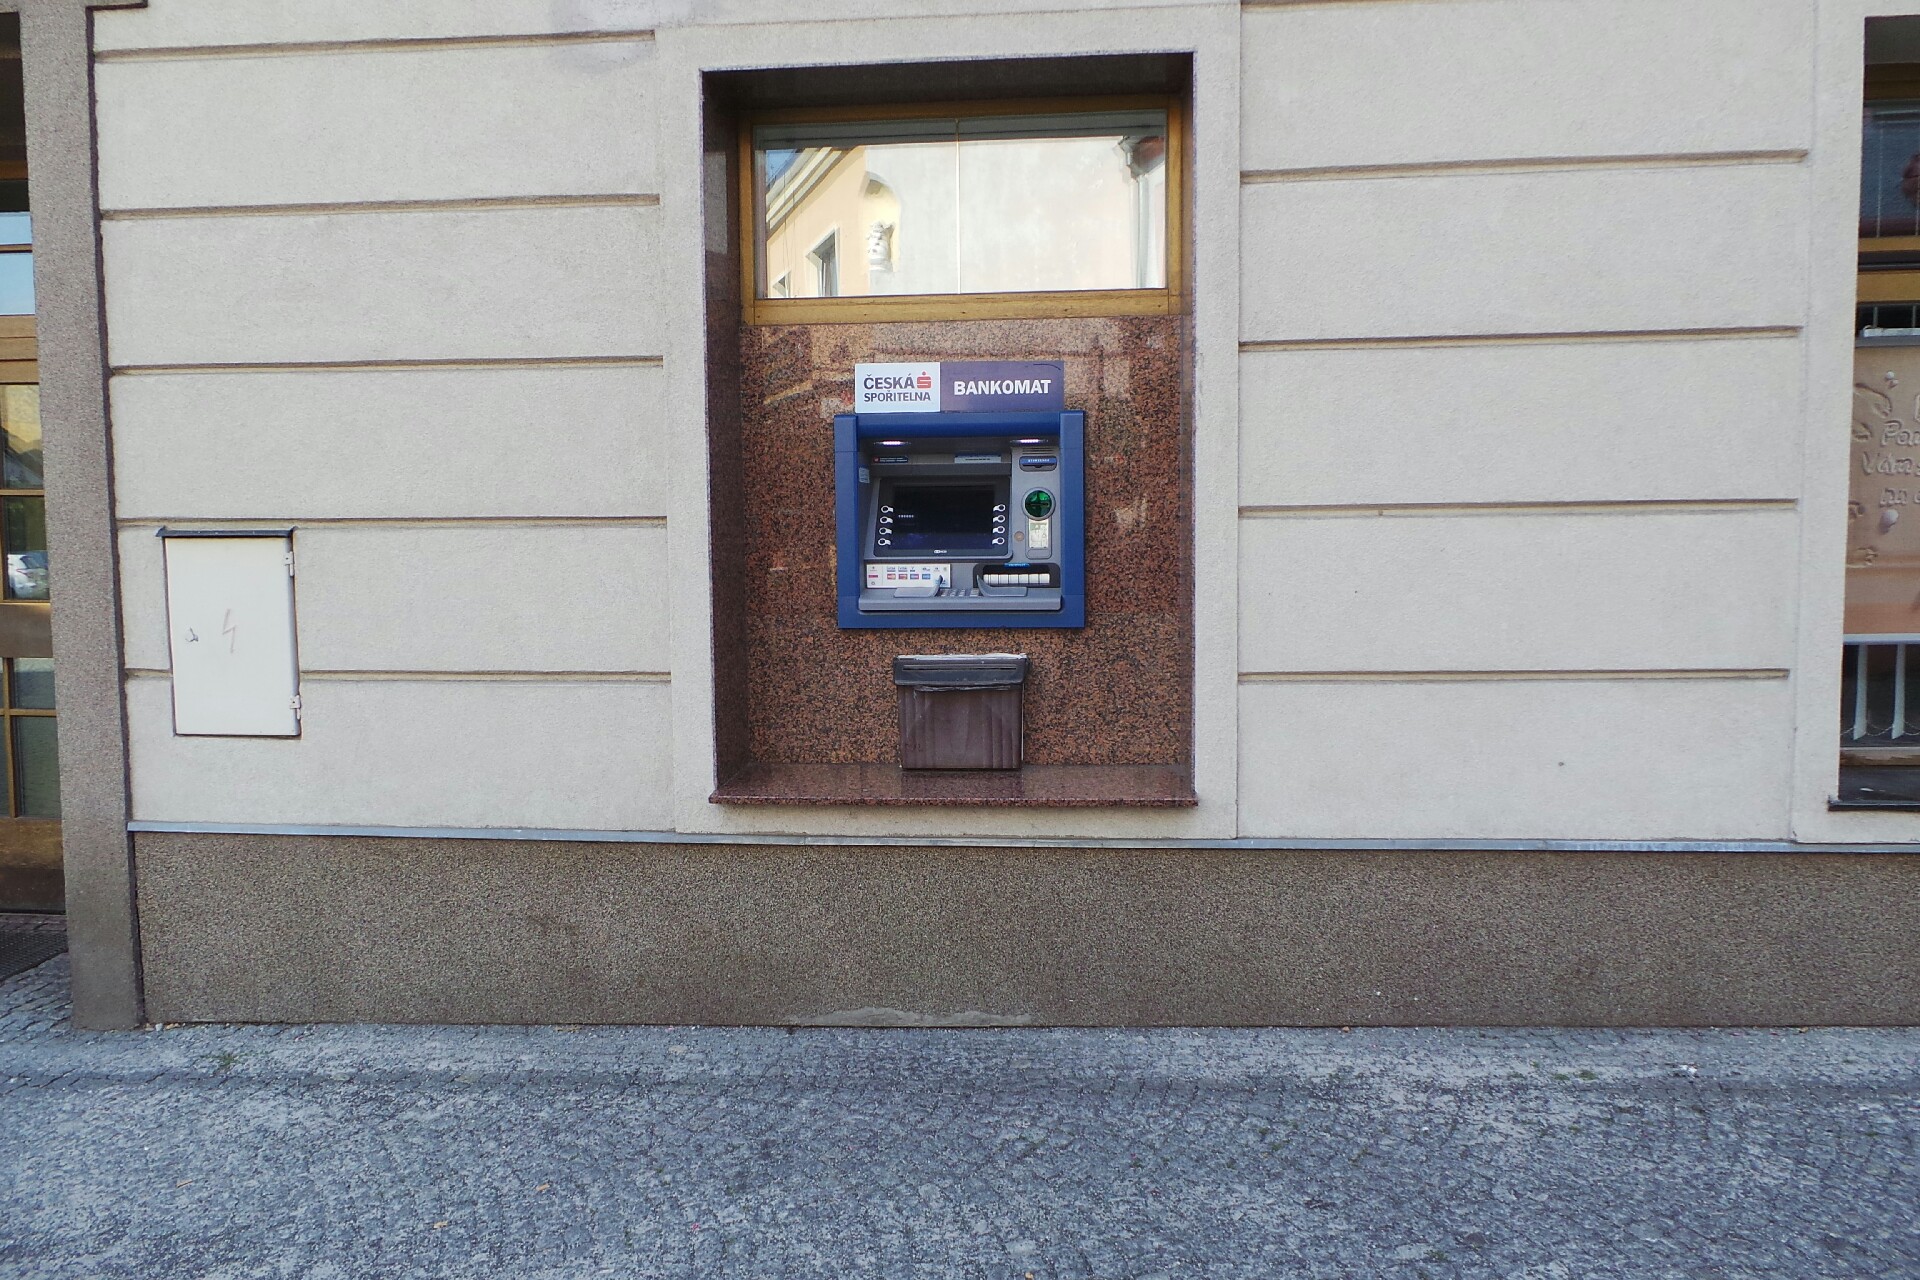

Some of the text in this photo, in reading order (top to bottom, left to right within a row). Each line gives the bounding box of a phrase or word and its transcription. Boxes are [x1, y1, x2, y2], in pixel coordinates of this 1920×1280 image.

[863, 373, 915, 390] ČESKÁ
[953, 379, 1052, 396] BANKOMAT
[863, 389, 932, 403] SPOŘITELNA
